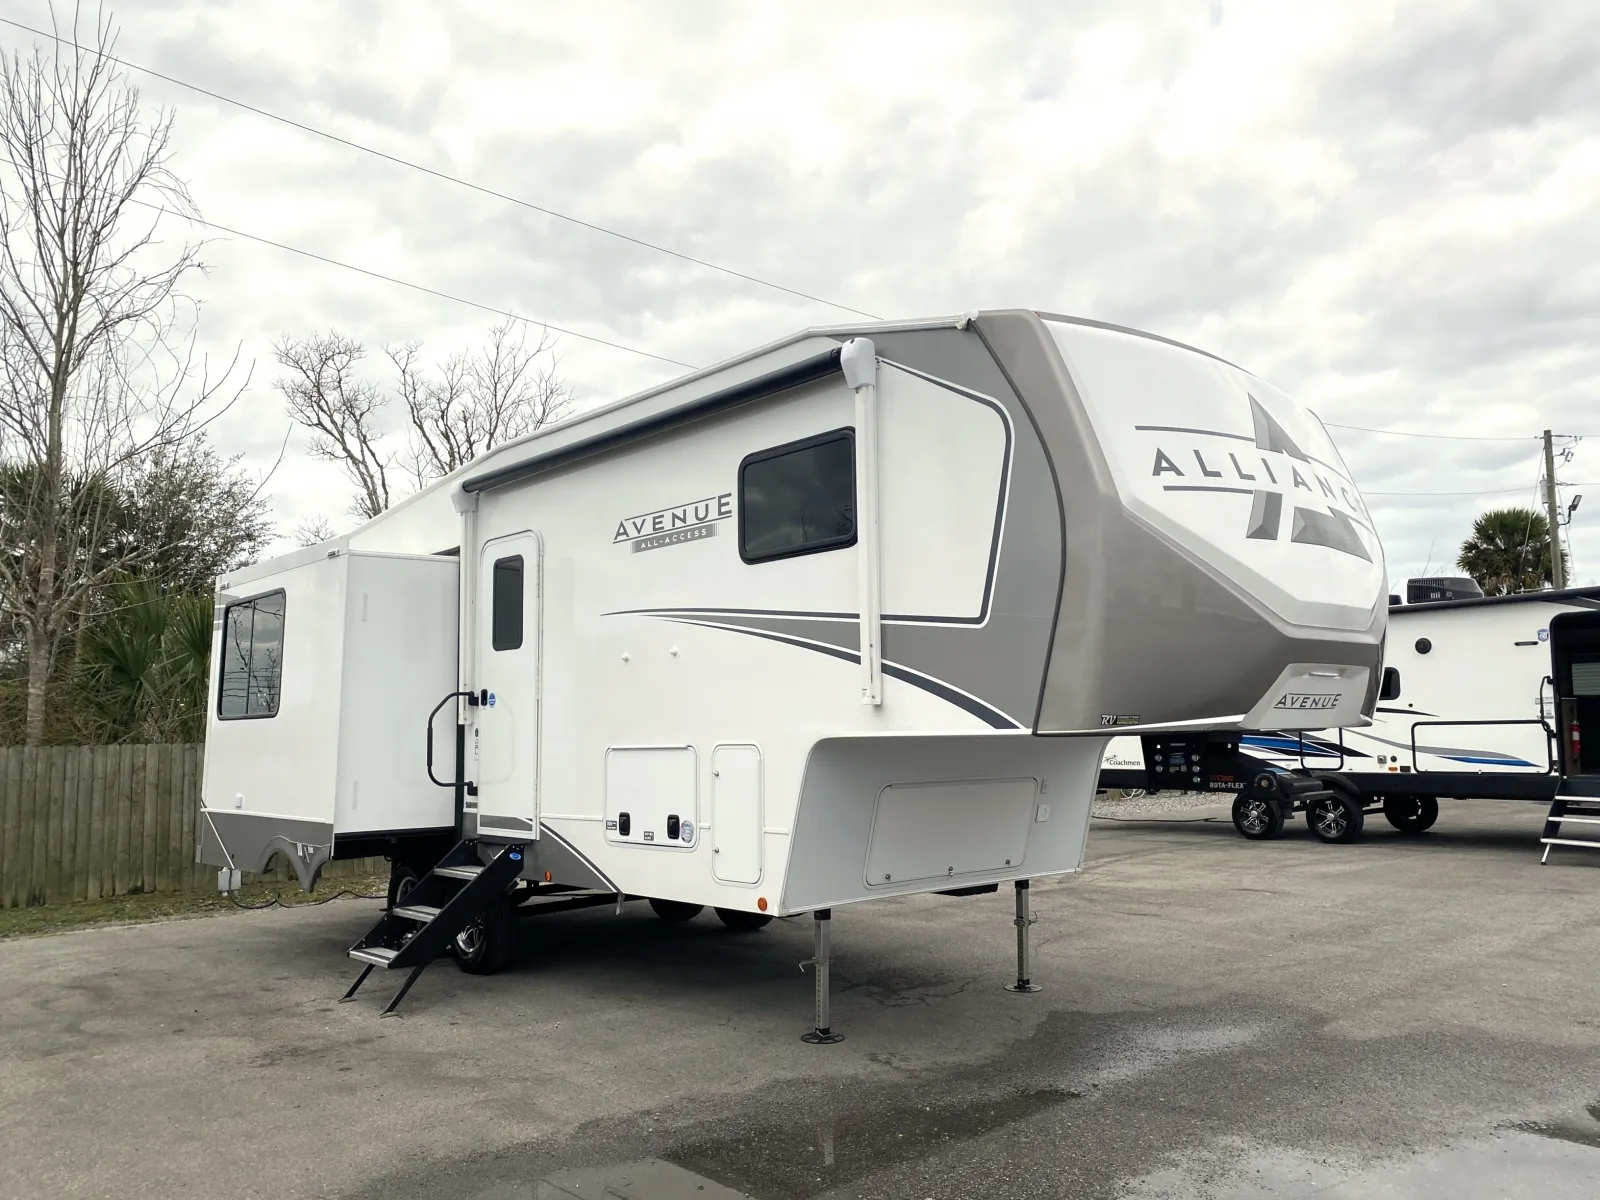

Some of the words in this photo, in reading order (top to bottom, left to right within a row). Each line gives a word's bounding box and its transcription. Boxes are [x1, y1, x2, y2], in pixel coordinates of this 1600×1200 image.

[613, 492, 732, 541] AVENUE
[640, 528, 707, 549] ALL-ACCESS
[1275, 693, 1342, 708] AVENUE
[1101, 714, 1117, 725] RV
